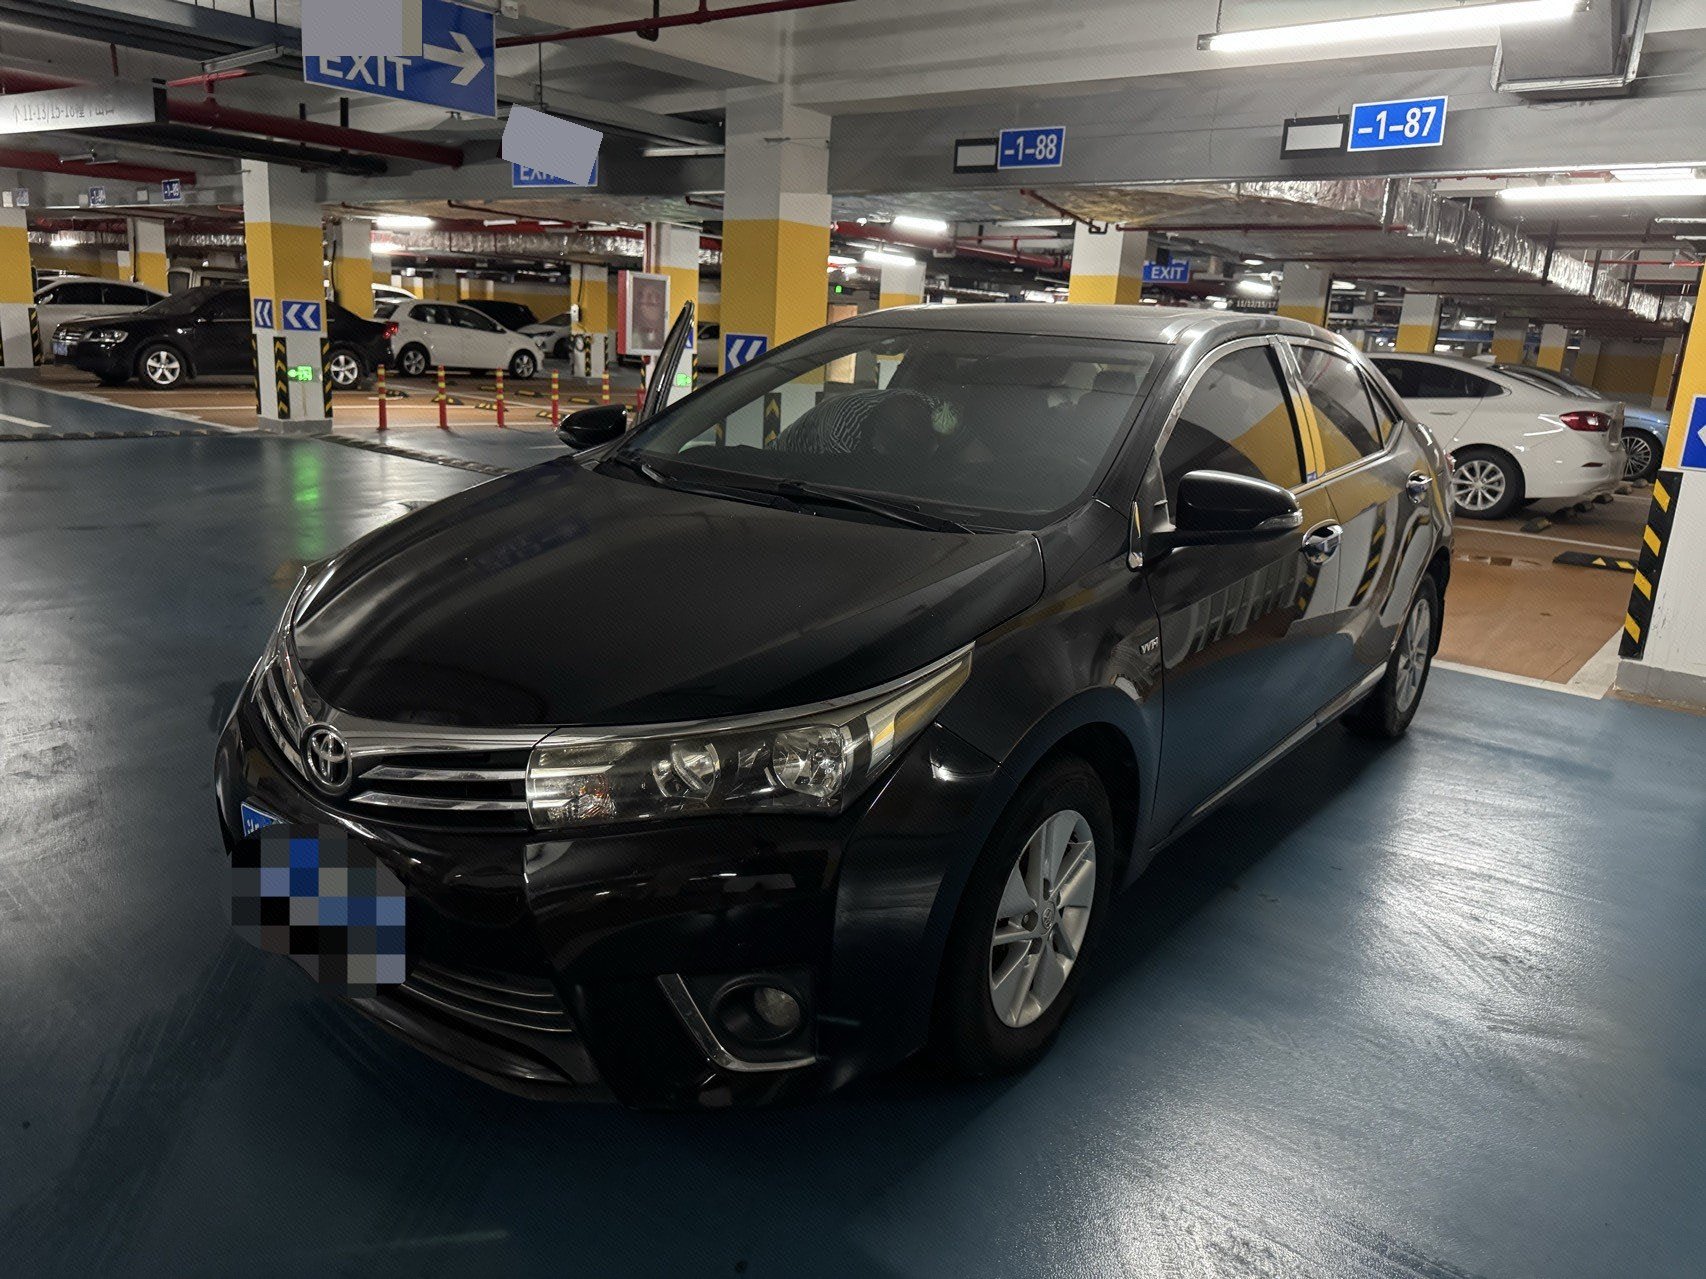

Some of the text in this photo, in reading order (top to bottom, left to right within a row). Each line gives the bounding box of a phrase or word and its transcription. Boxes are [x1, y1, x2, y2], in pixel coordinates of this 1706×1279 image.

[319, 56, 412, 91] EXIT
[1358, 106, 1437, 140] -1-87
[1004, 134, 1057, 161] -1-88
[1151, 266, 1185, 279] EXIT
